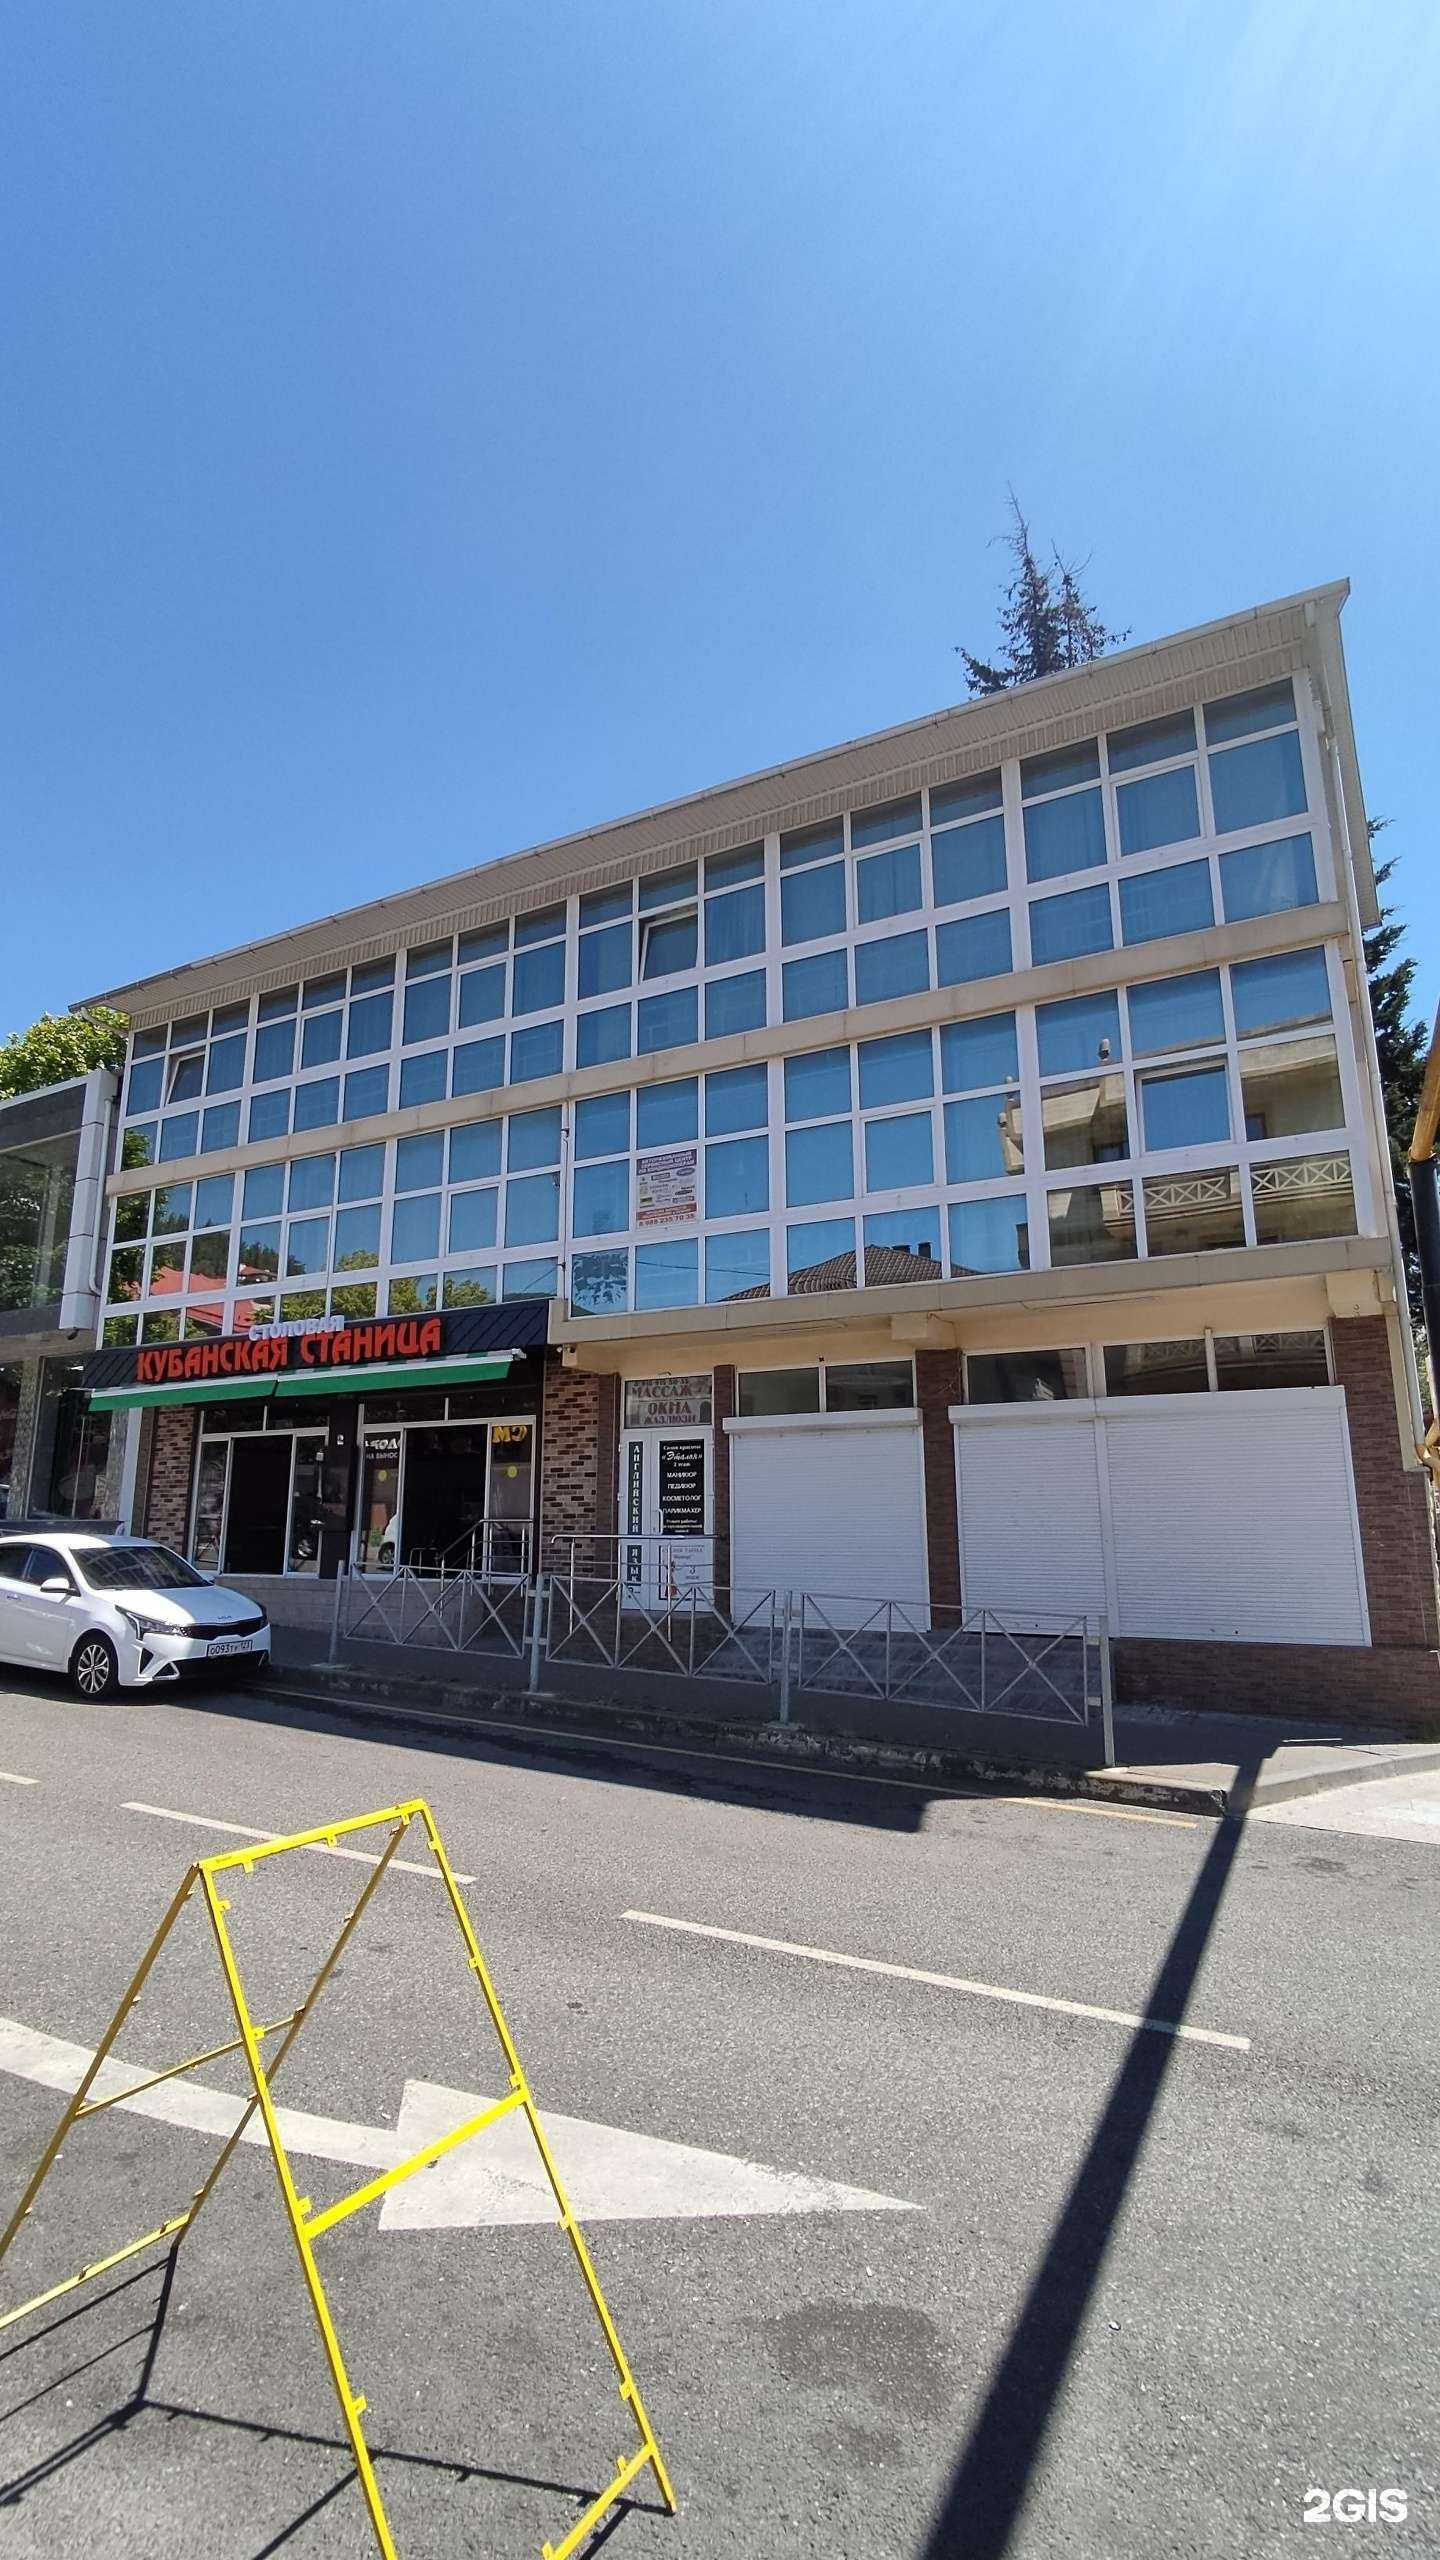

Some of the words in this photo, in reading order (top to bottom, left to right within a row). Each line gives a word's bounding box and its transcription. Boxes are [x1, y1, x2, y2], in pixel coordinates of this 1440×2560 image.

[248, 1315, 345, 1341] СТОЛОВАЯ
[136, 1337, 288, 1382] КУБАНСКАЯ
[300, 1317, 442, 1364] СТАНИЦА
[632, 1385, 692, 1398] МАССАЖ
[647, 1401, 692, 1415] ОКНА
[632, 1445, 640, 1533] АНГЛИЙСКИЙ
